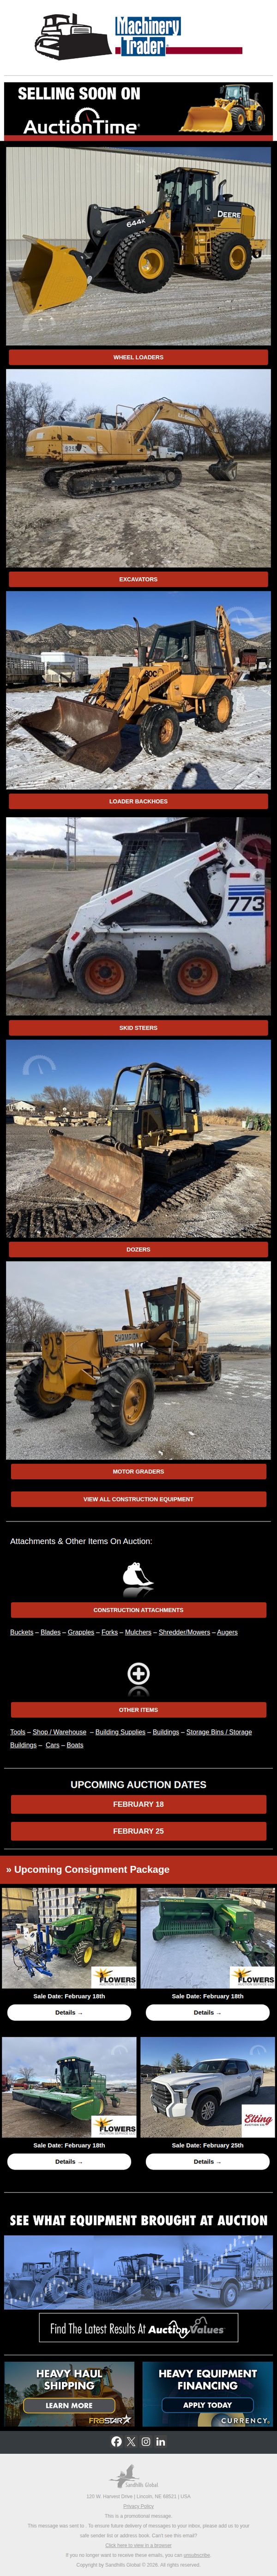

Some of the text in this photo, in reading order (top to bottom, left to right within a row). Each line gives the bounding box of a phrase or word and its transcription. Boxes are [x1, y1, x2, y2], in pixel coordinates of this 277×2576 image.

[117, 18, 179, 35] Machinery
[124, 37, 163, 54] Trader
[18, 87, 140, 100] SELLING SOON ON
[23, 120, 137, 134] AuctionTime
[126, 218, 146, 228] 644K
[228, 896, 265, 911] 773
[114, 1333, 138, 1342] CHAMPION
[15, 1865, 169, 1875] Upcoming Consignment Package
[10, 2215, 267, 2226] SEE WHAT EQUIPMENT BROUGHT AT AUCTION
[51, 2323, 146, 2334] Find The Latest Results At
